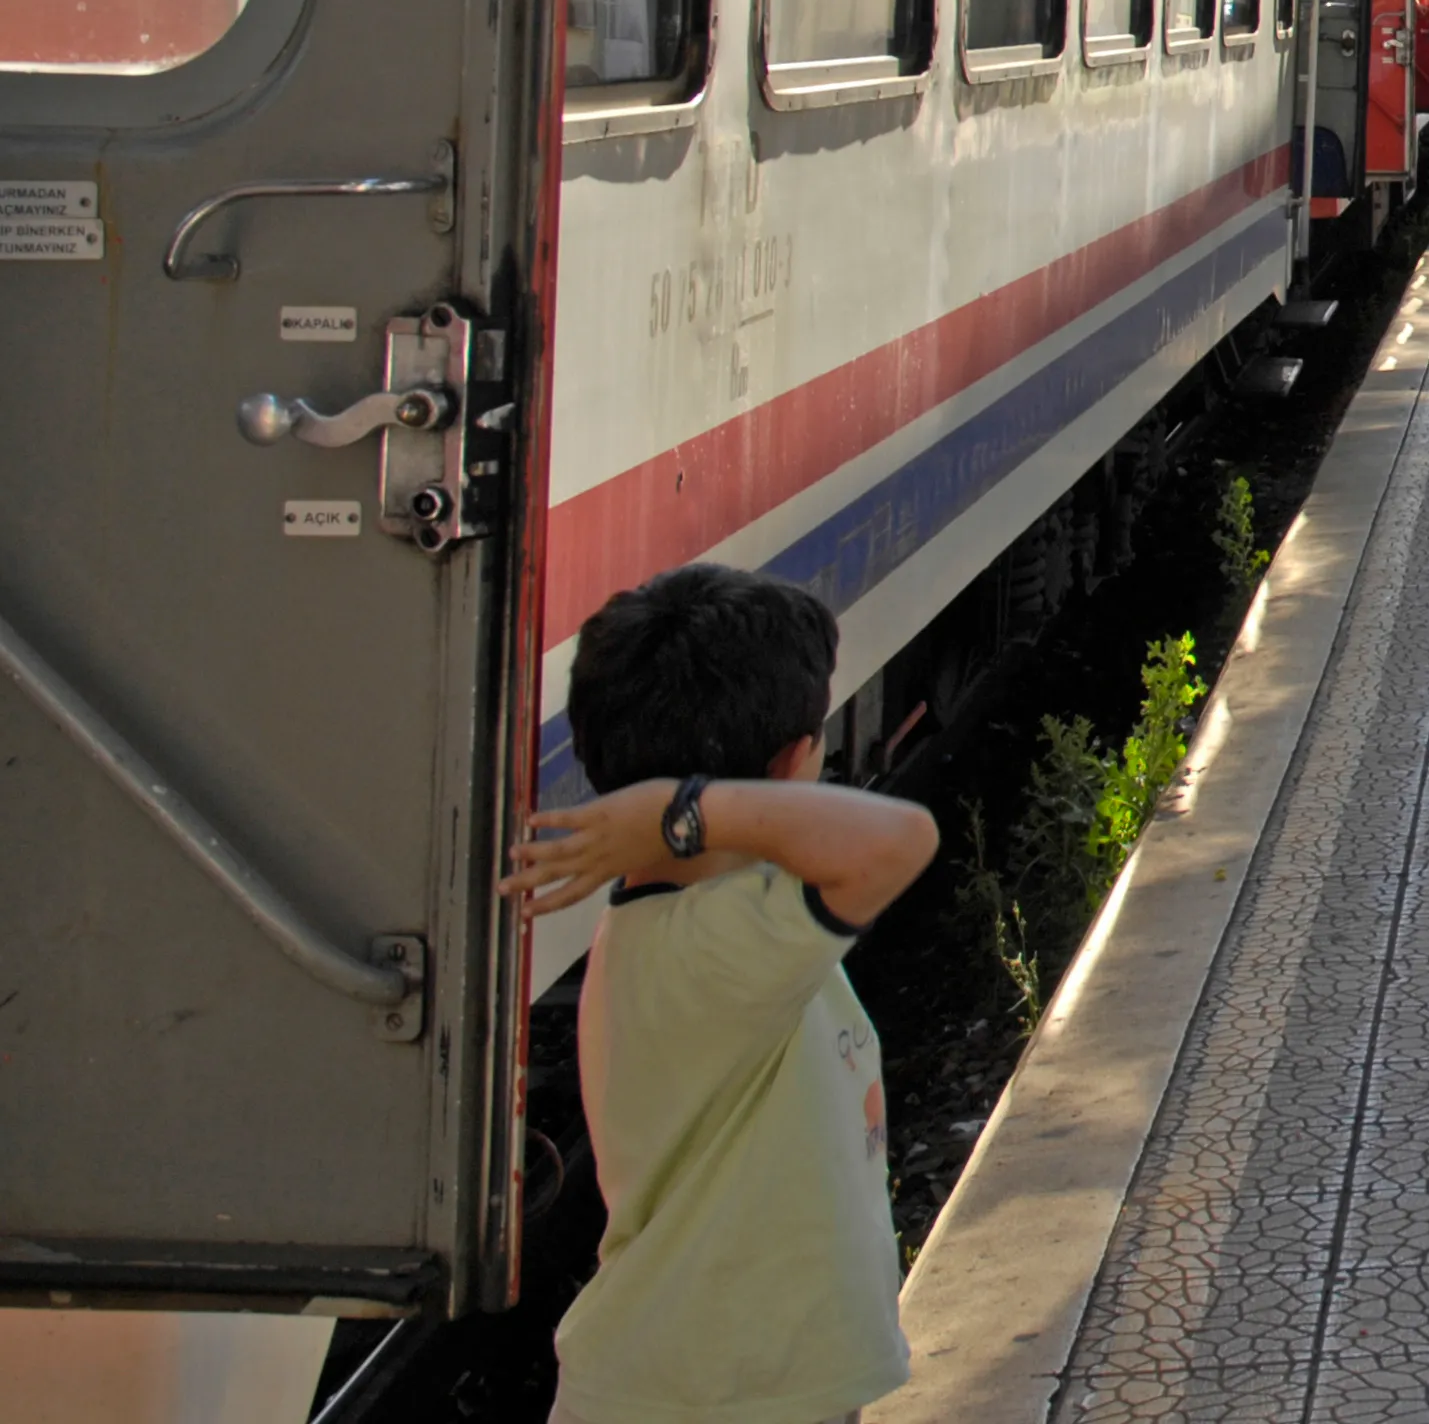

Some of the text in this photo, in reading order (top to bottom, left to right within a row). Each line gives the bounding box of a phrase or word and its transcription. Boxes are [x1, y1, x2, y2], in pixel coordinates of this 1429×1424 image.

[16, 223, 86, 236] BİNERKEN
[293, 317, 345, 331] KAPALI
[303, 512, 341, 526] AÇIK
